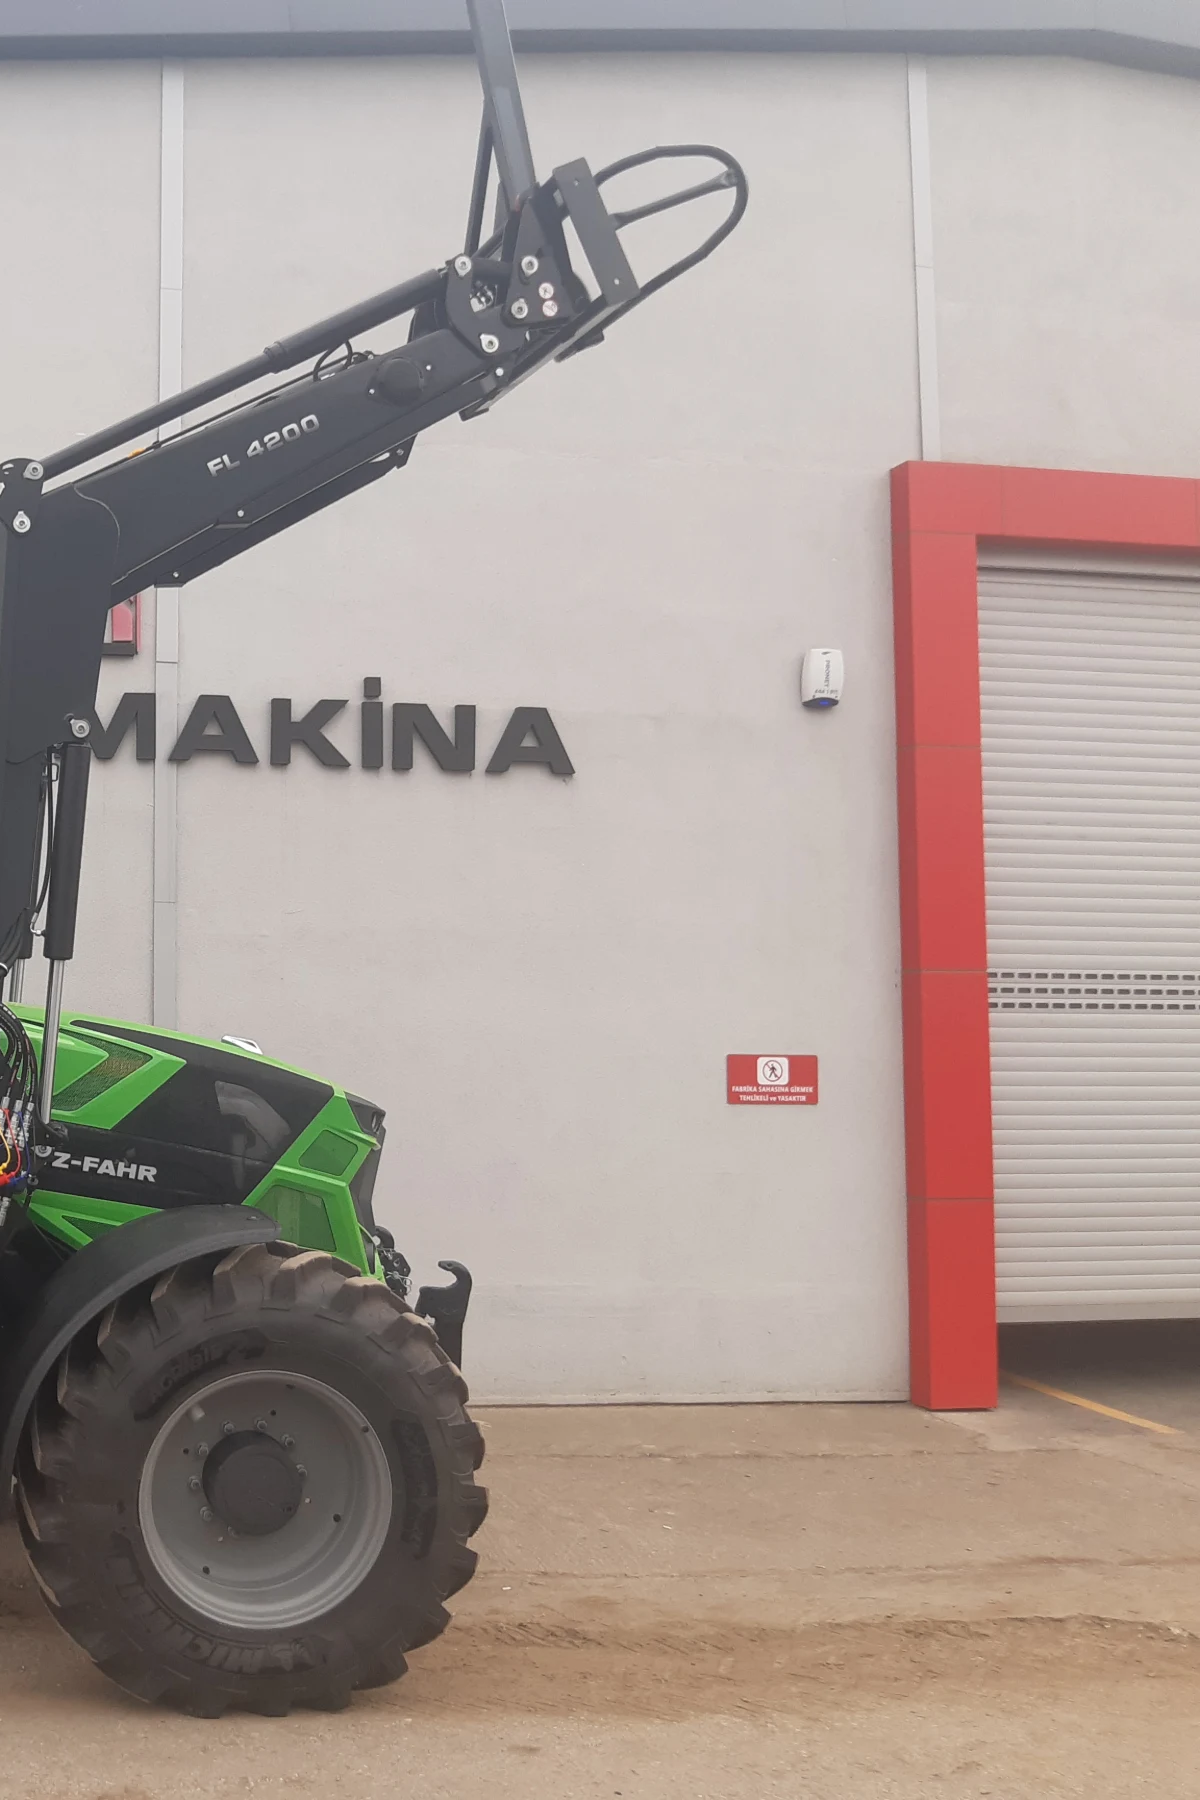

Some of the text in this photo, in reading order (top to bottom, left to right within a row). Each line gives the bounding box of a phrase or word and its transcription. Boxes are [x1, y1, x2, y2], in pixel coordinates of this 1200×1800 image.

[207, 414, 320, 477] FL 4200
[731, 1085, 757, 1093] FABRİKA
[52, 1151, 158, 1183] Z-FAHR
